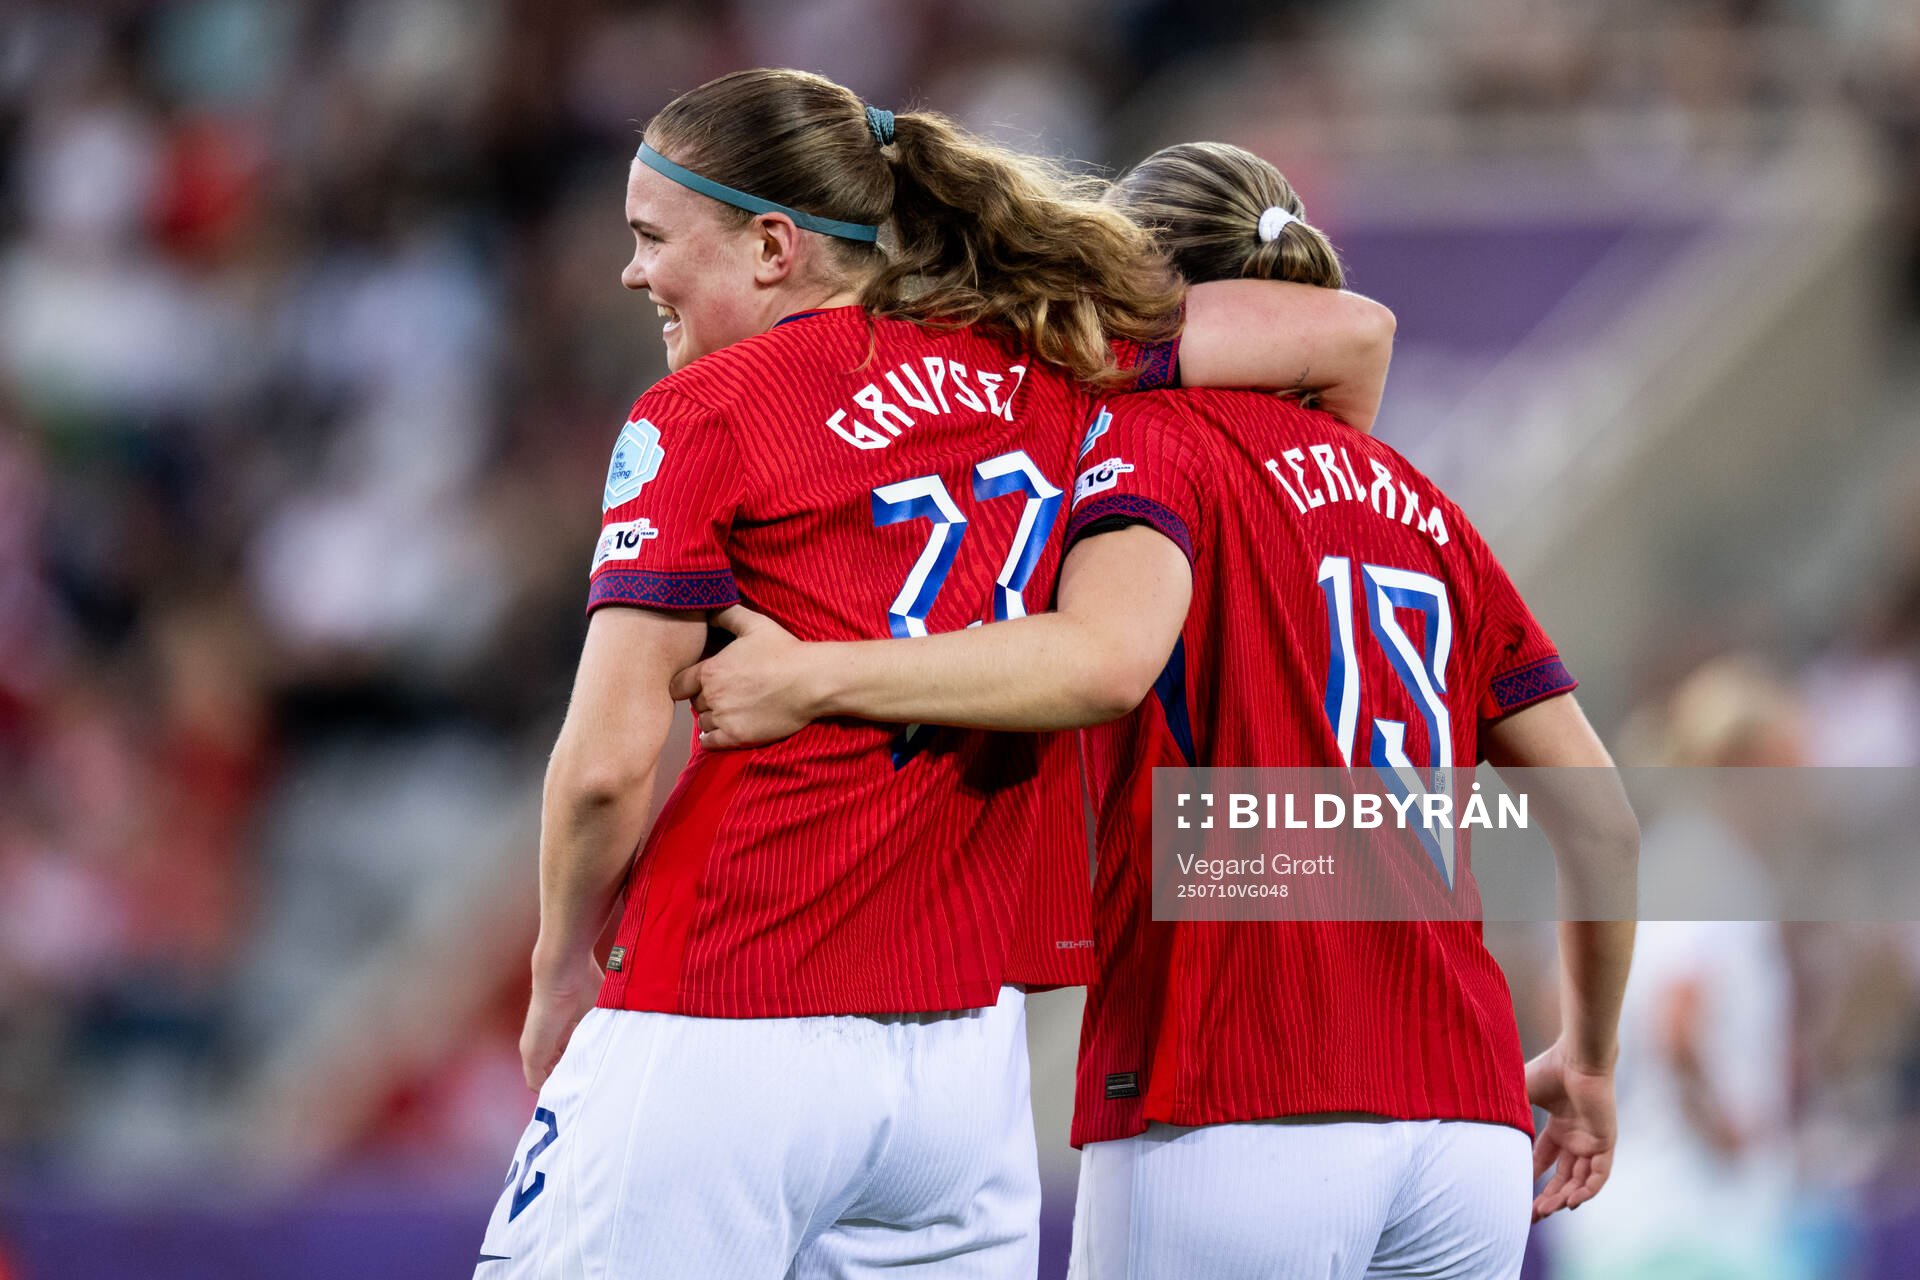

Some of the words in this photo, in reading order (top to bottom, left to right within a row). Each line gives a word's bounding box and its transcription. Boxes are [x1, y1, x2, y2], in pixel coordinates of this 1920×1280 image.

[1085, 468, 1114, 487] 10
[615, 530, 640, 549] 10
[1317, 555, 1455, 893] 19
[503, 1106, 559, 1224] 2
